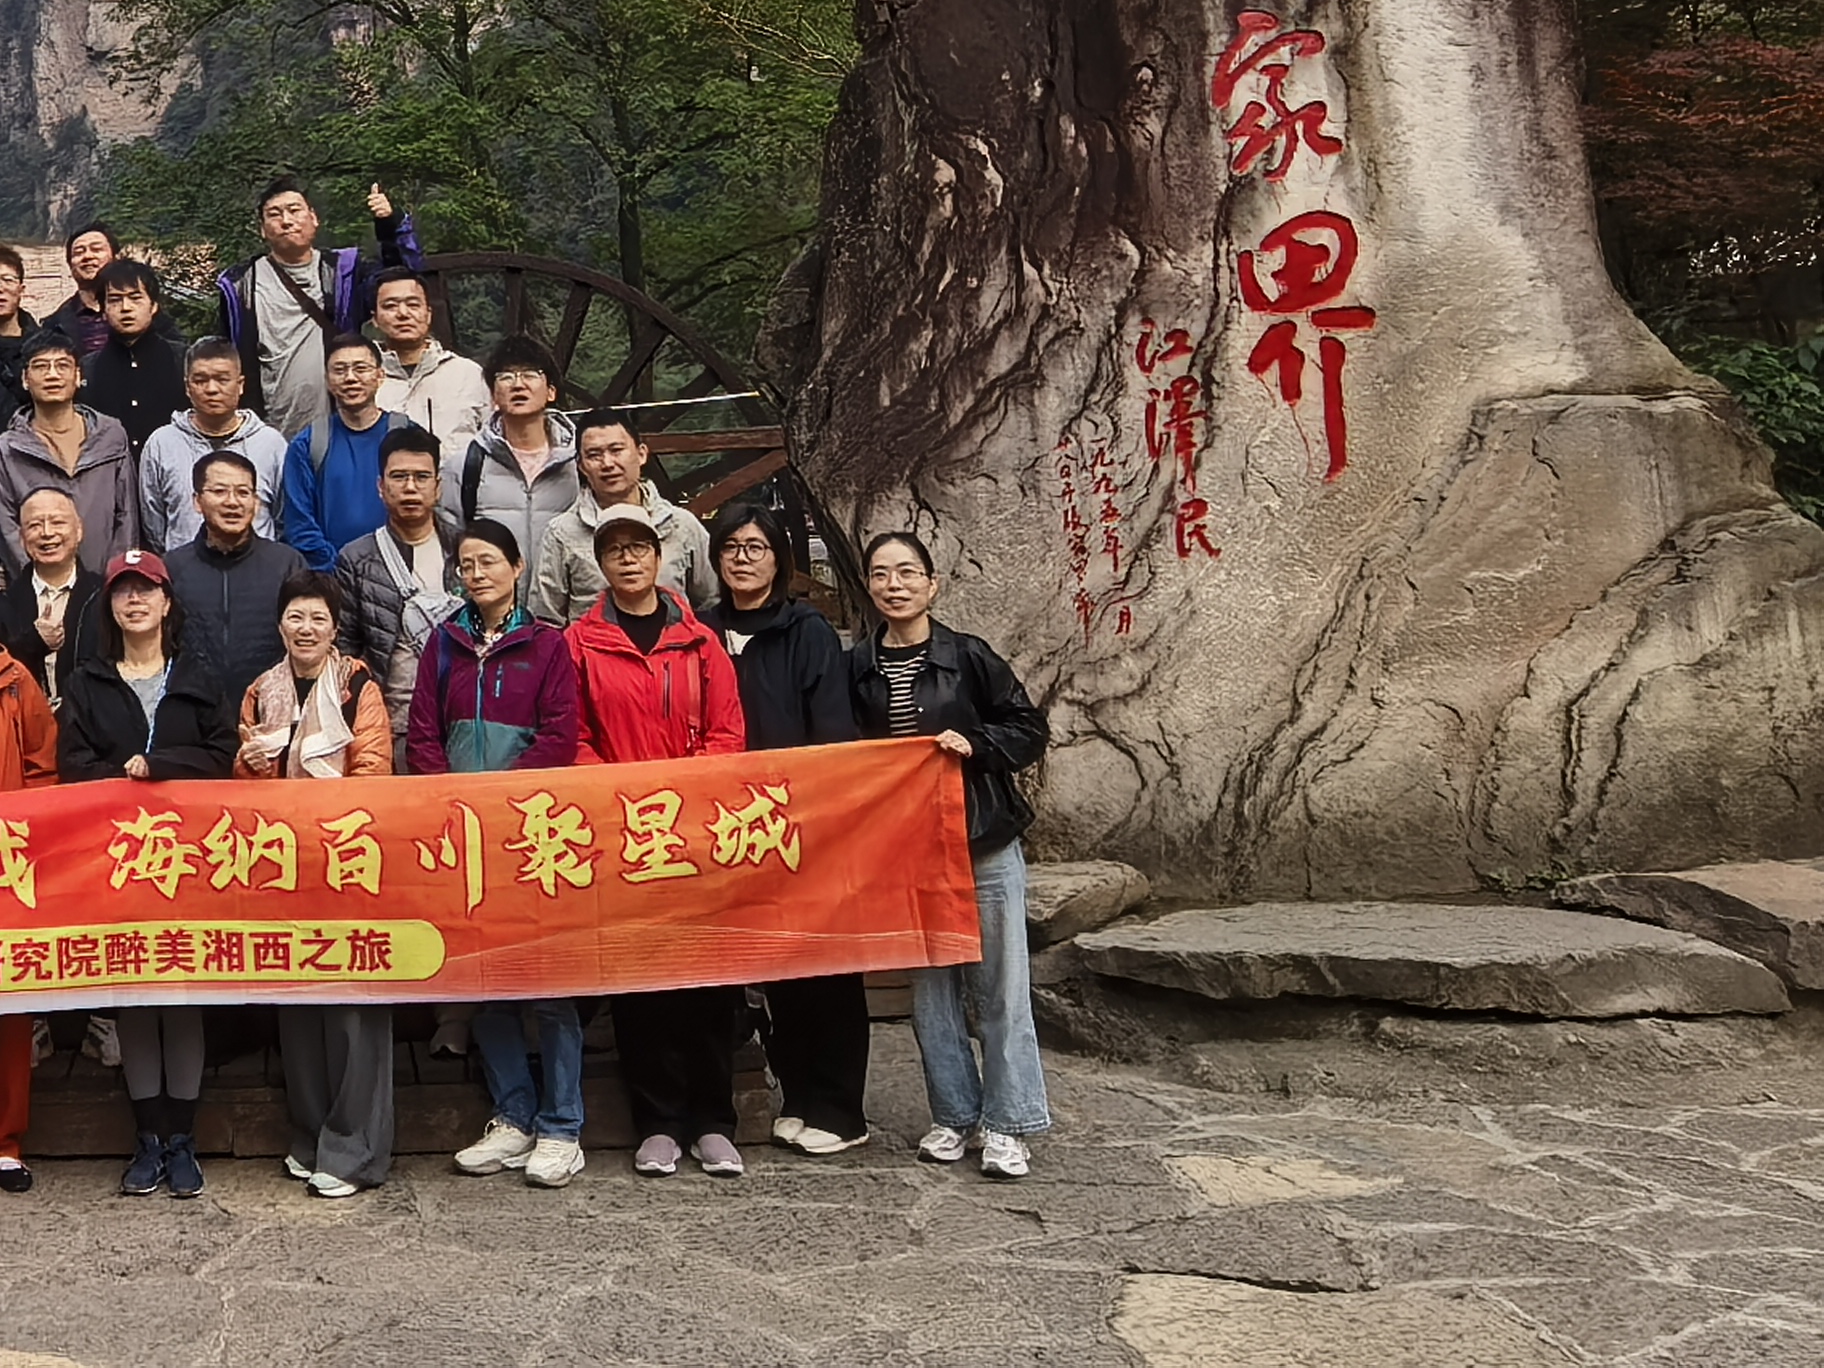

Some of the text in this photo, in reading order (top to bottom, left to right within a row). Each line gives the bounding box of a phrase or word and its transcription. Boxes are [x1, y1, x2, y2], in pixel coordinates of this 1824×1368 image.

[107, 782, 802, 917] 海纳百川聚星城
